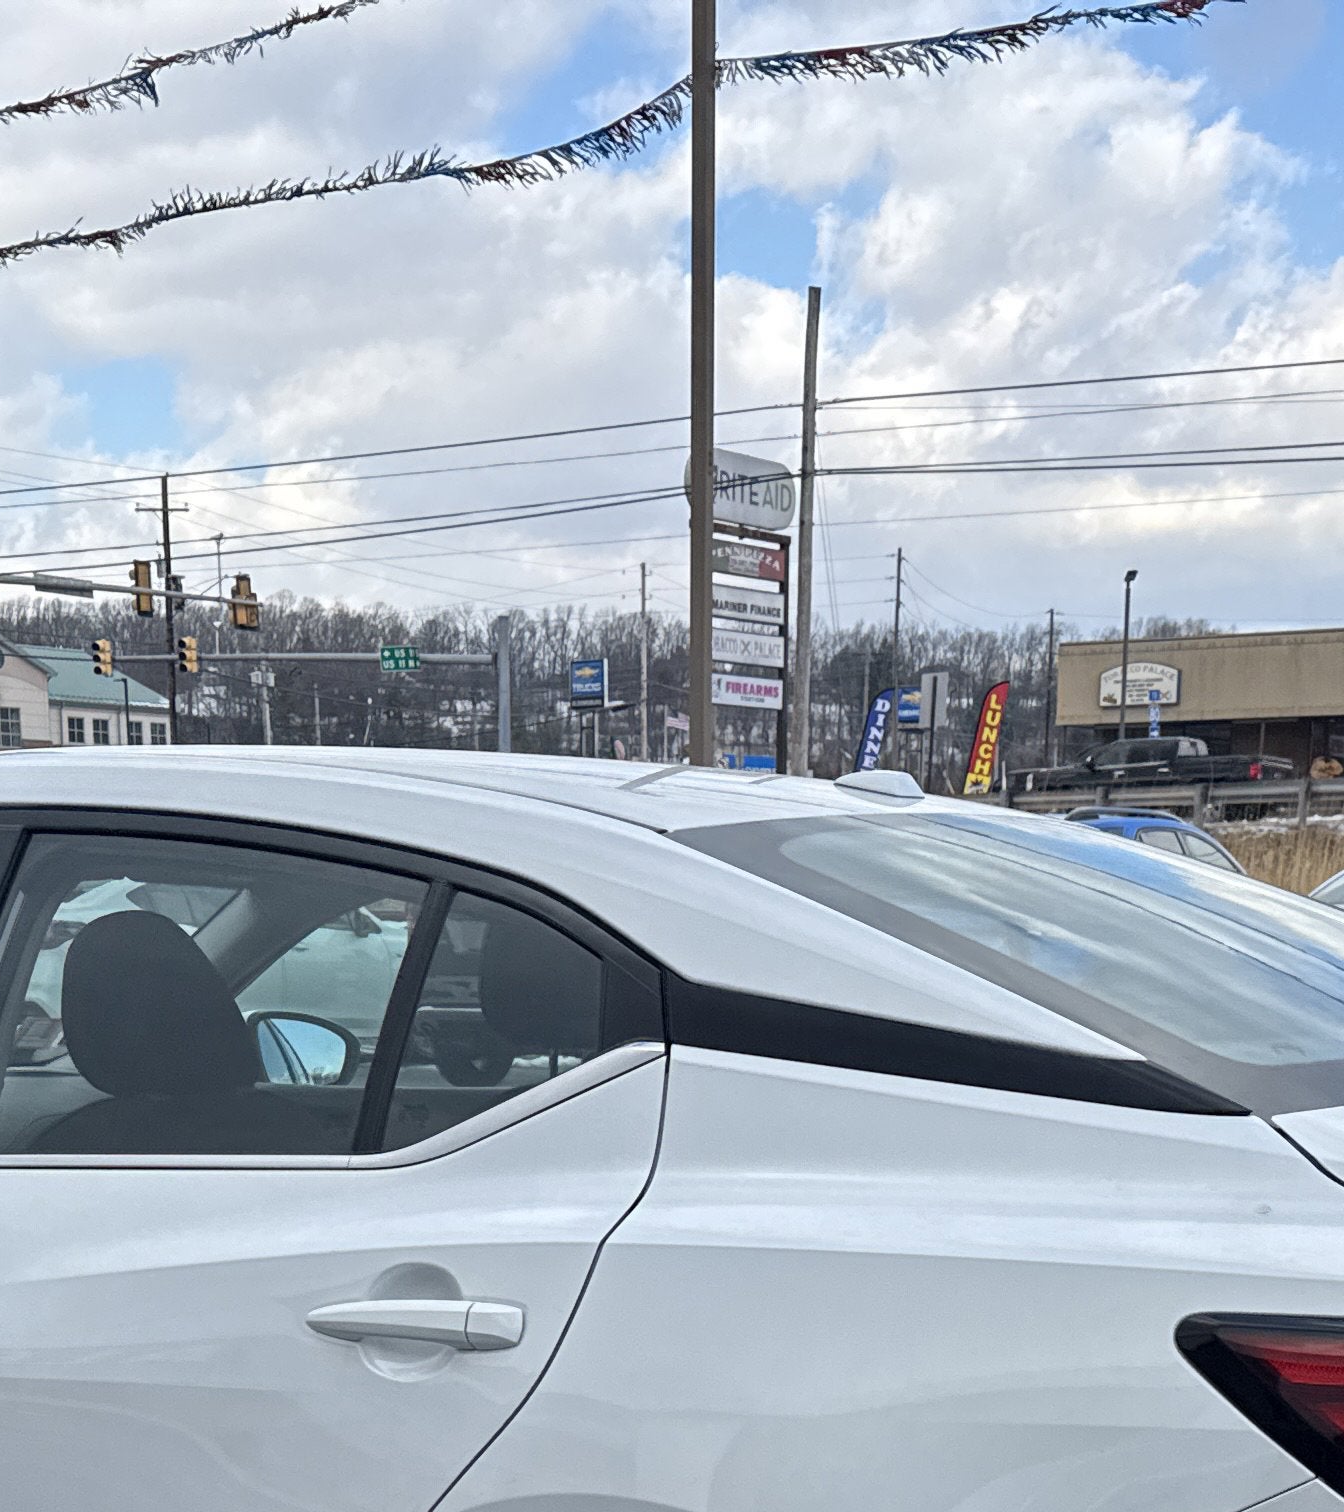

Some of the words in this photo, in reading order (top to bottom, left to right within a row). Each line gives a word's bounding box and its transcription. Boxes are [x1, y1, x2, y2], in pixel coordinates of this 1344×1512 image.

[719, 469, 760, 507] RITE
[761, 480, 793, 512] AID
[750, 604, 781, 619] FINANCE
[725, 681, 779, 698] FIREARMS
[860, 698, 891, 772] DINNE
[974, 694, 1002, 776] LUNCH
